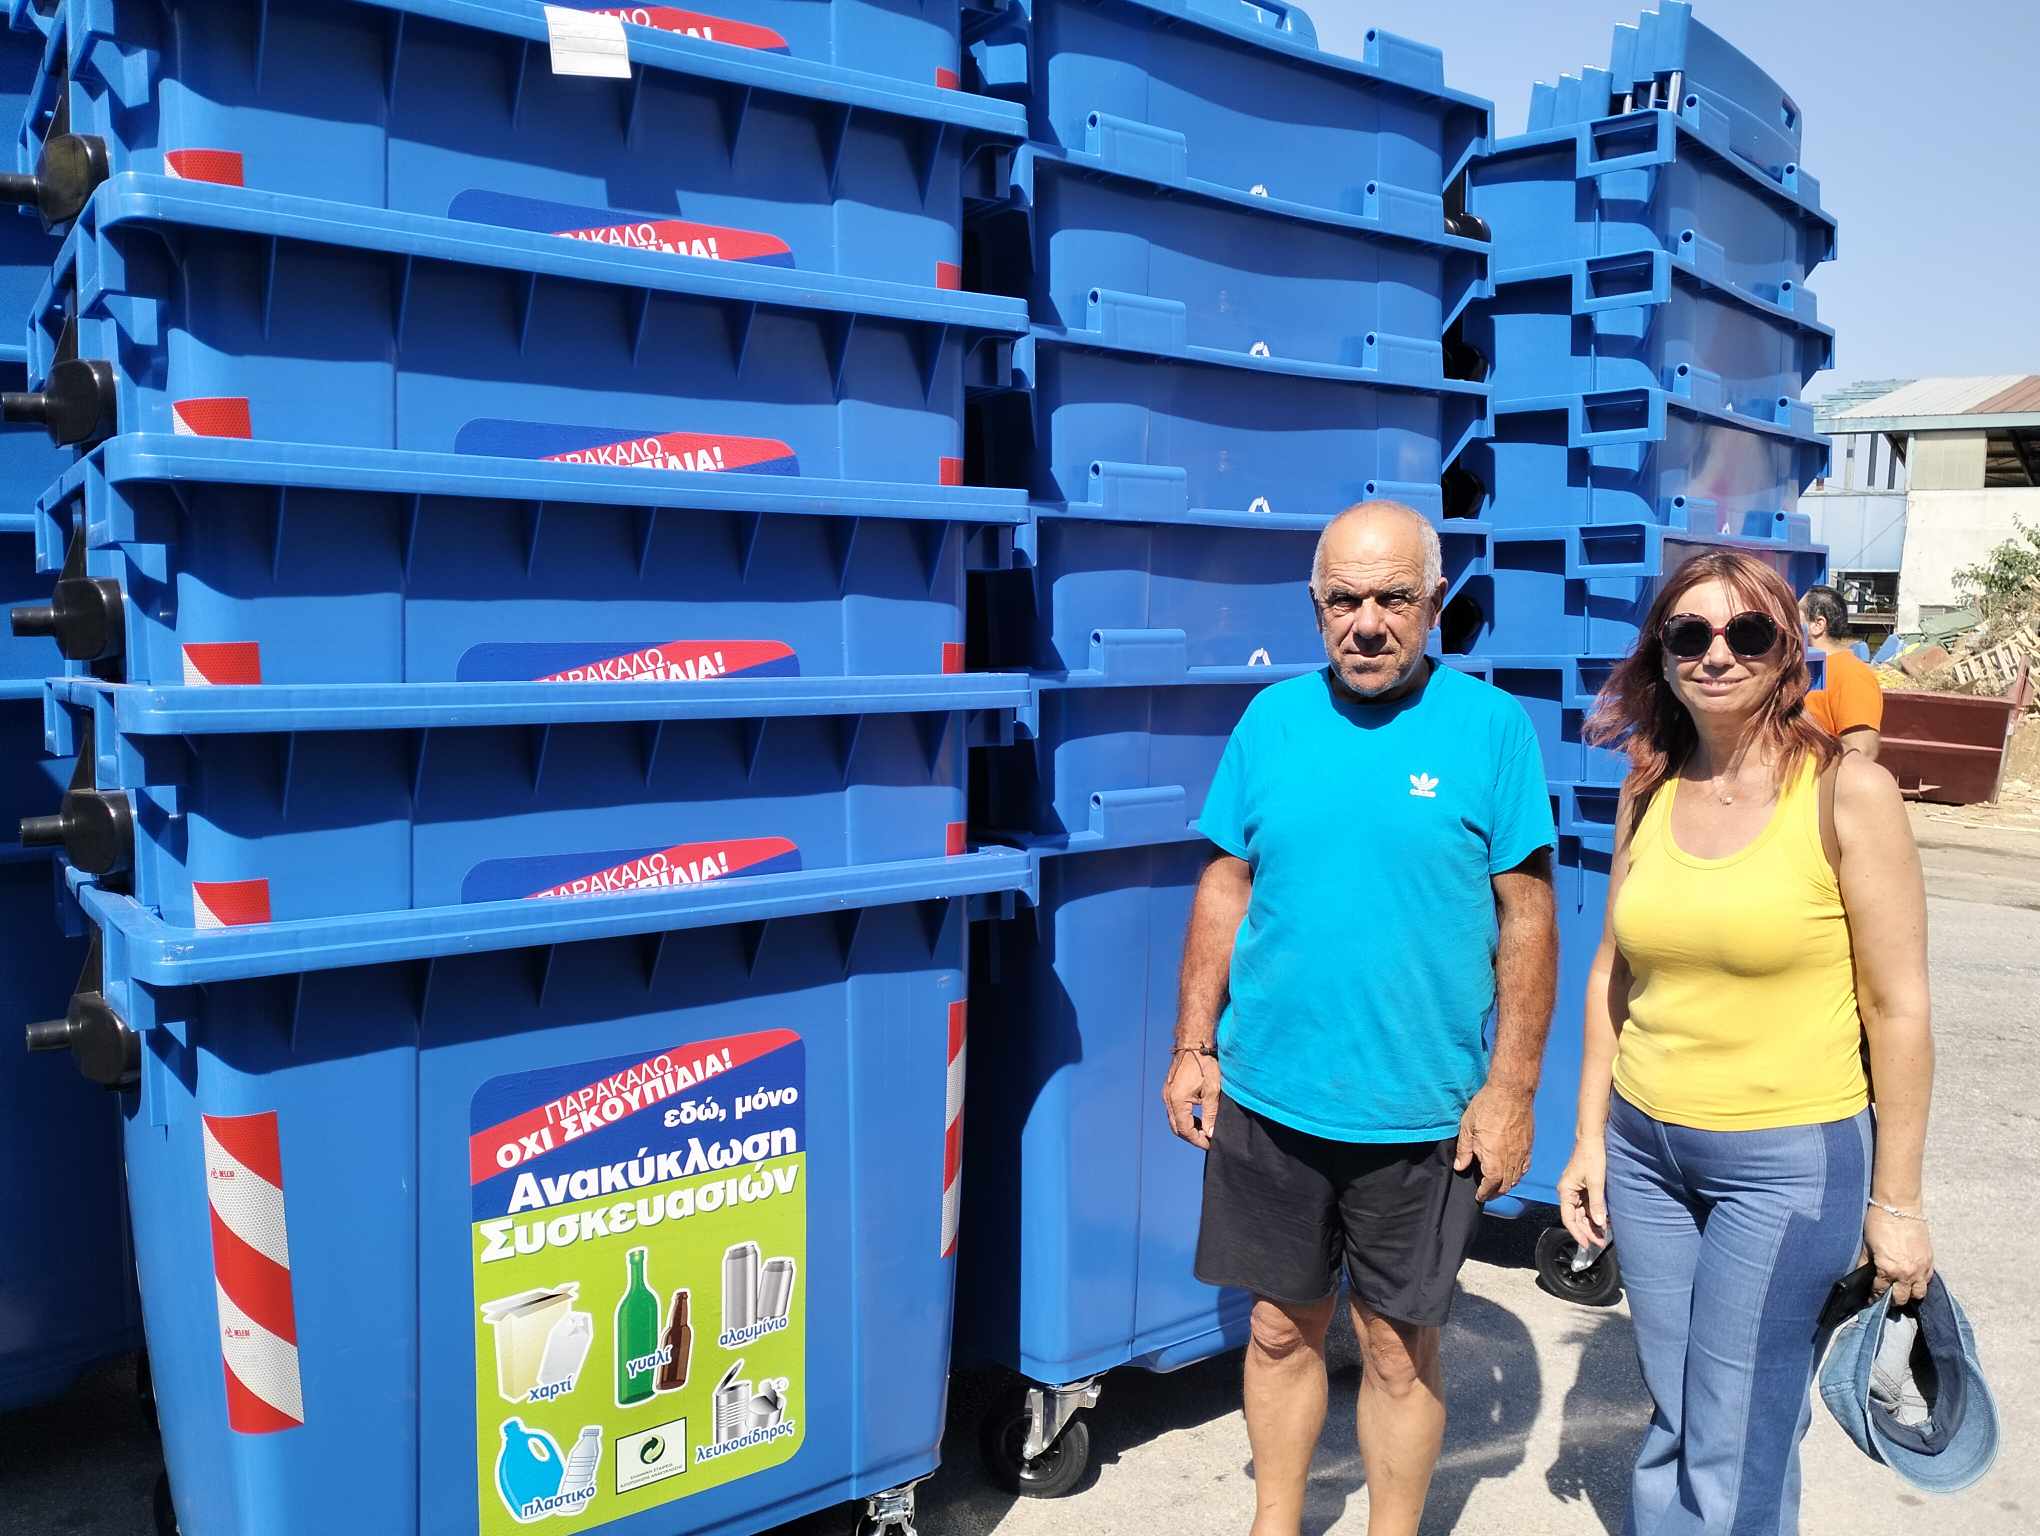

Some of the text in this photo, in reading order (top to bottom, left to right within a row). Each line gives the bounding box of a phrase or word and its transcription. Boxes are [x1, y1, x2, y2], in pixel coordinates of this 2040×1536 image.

[553, 438, 669, 466] ΑΚΑΛΩ,
[543, 648, 671, 682] ΡΑΚΑΛΩ,
[537, 853, 675, 898] ΑΡΑΚΑΛΩ,
[496, 1047, 734, 1169] ΟΧΙ ΣΚΟΥΠΙΔΙΑ!
[544, 1054, 679, 1124] ΠΑΡΑΚΑΛΩ,
[663, 1085, 799, 1128] εδώ, μόνο
[507, 1126, 797, 1215] Ανακύκλωση
[480, 1162, 799, 1264] Συσκευασιών
[719, 1315, 788, 1346] αλουμίνιο
[627, 1346, 672, 1377] γυαλί
[529, 1377, 574, 1401] χαρτί
[695, 1420, 794, 1462] λευκοσίδηρος
[523, 1483, 596, 1518] πλαστικό
